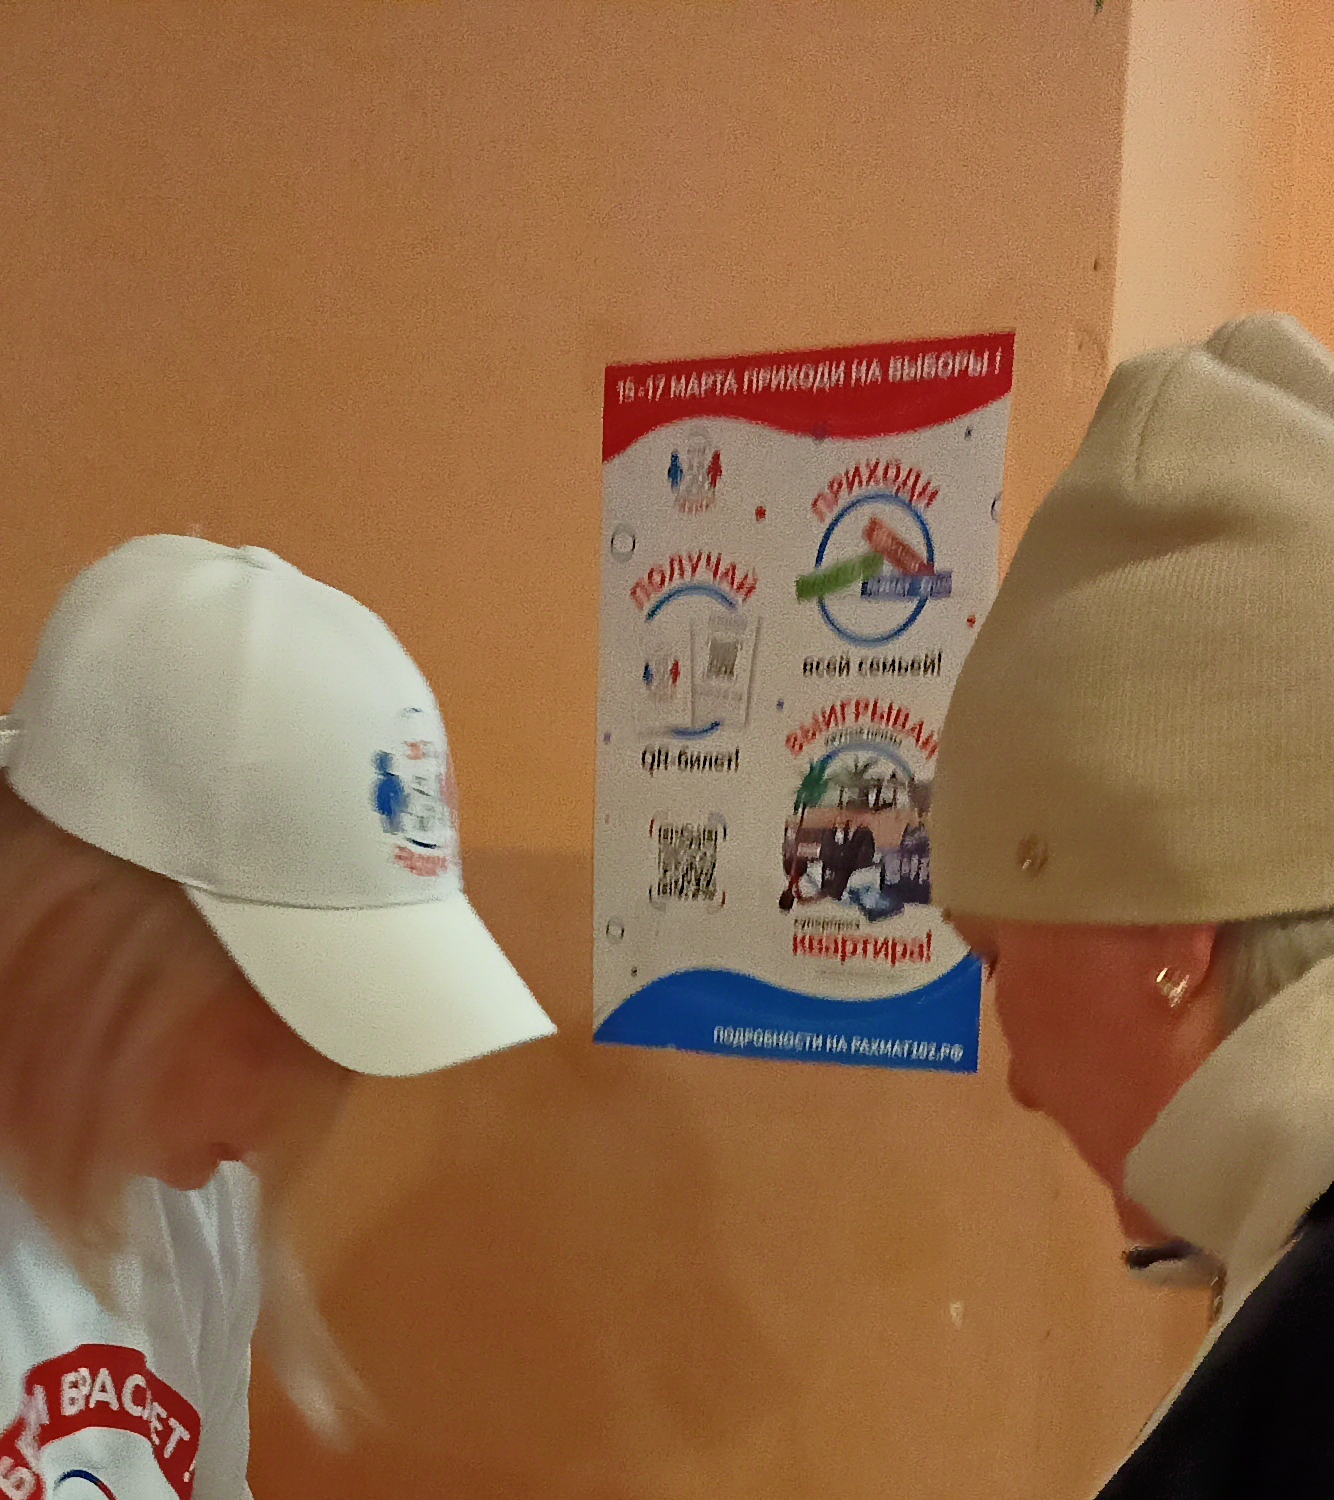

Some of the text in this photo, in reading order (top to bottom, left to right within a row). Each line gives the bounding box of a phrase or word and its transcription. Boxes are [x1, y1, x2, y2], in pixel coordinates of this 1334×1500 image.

[670, 369, 738, 399] МАРТА
[743, 360, 846, 394] ПРИХОДИ
[851, 357, 883, 386] НА
[888, 350, 988, 383] ВЫБОРЫ
[811, 458, 940, 523] ПРИХОДИ
[630, 549, 759, 611] ПОЛУЧАЙ
[792, 929, 933, 967] квартира!
[713, 1024, 823, 1053] ПОДРОБНОСТИ
[826, 1033, 848, 1054] НА
